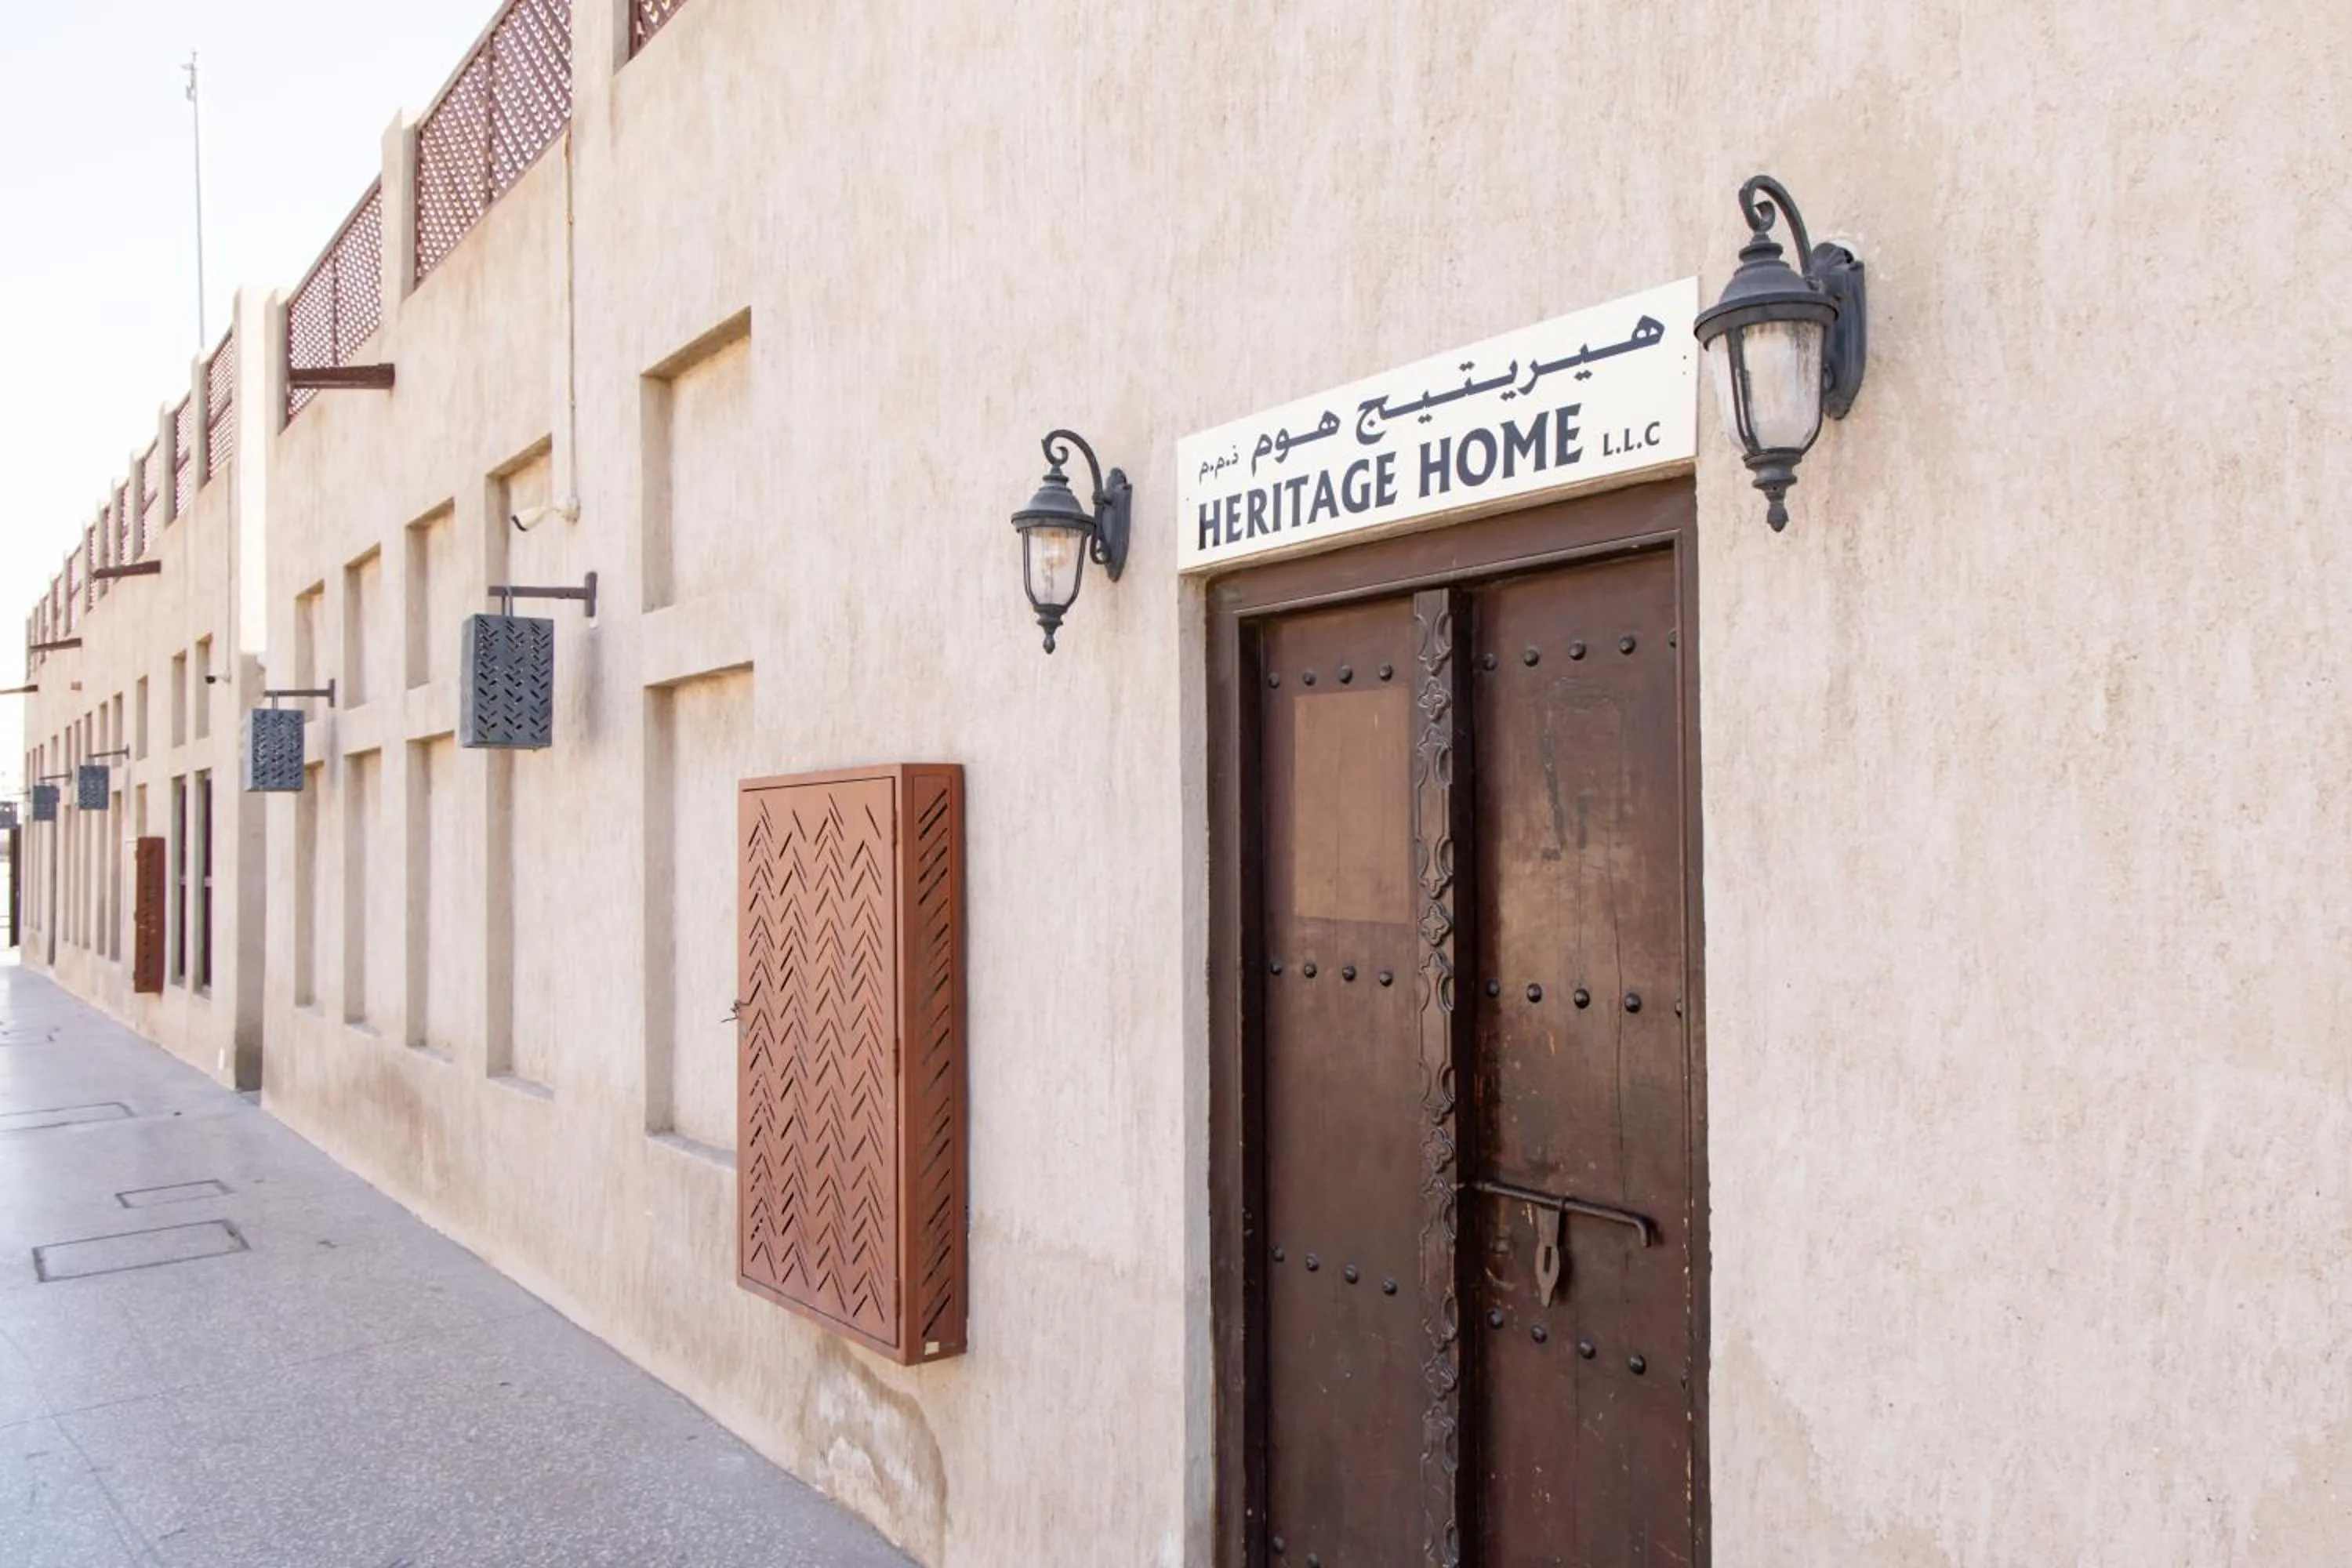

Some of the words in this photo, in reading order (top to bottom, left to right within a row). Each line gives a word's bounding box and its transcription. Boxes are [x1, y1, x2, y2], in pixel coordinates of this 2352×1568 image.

[1250, 410, 1341, 477] هوم
[1356, 314, 1665, 445] هيريتيج
[1197, 451, 1398, 551] HERITAGE
[1418, 401, 1584, 499] HOME
[1602, 420, 1661, 456] L.L.C
